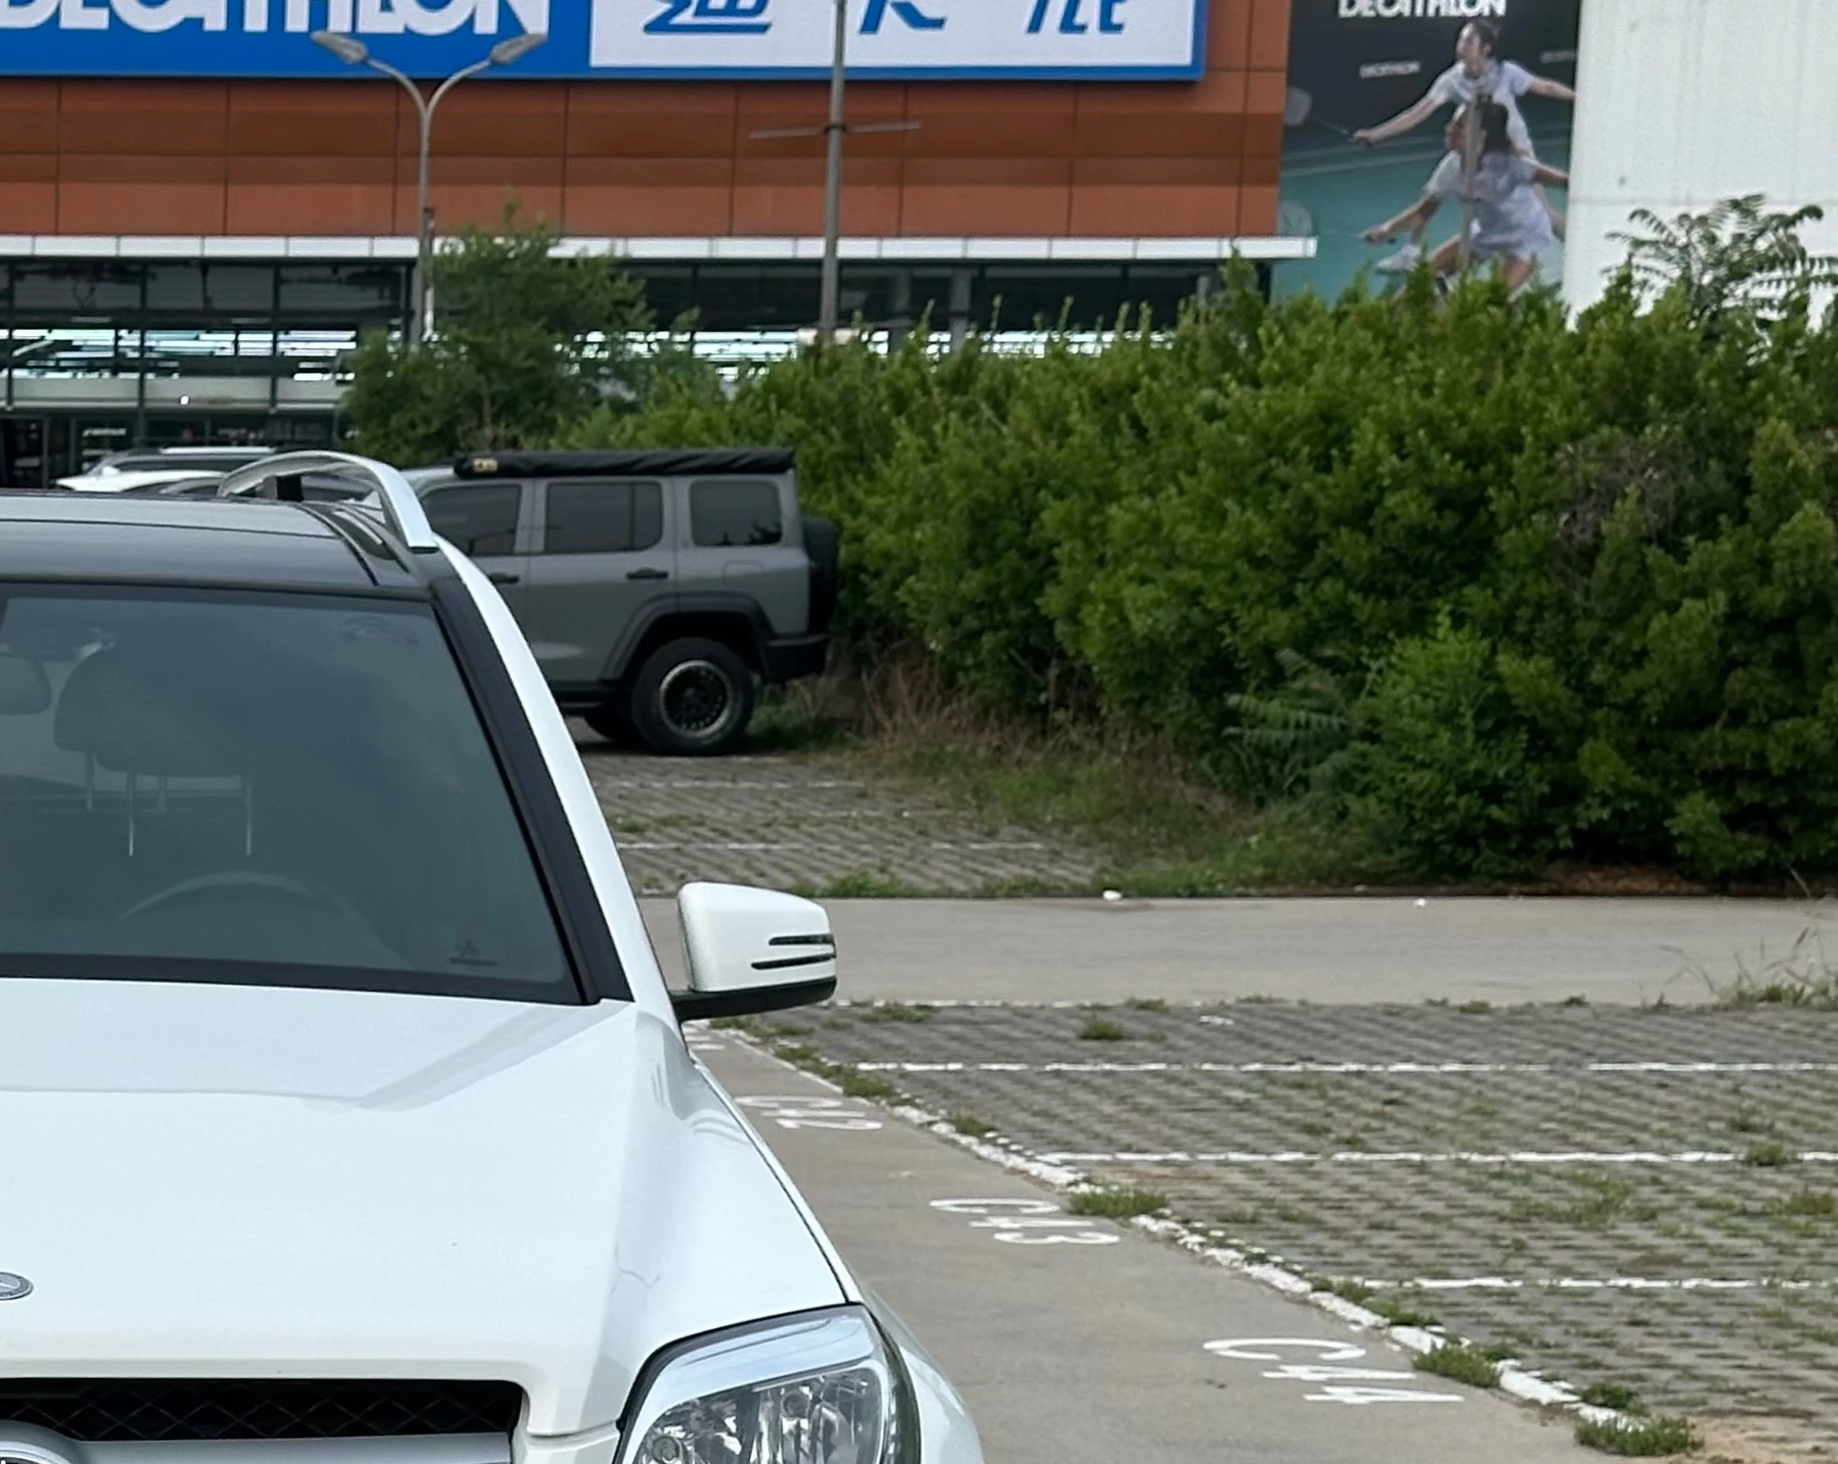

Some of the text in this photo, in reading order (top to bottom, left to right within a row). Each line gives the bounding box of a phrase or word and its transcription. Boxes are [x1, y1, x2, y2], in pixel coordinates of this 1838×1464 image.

[735, 1096, 882, 1130] C42
[929, 1198, 1120, 1244] C43
[1203, 1337, 1465, 1404] C44
